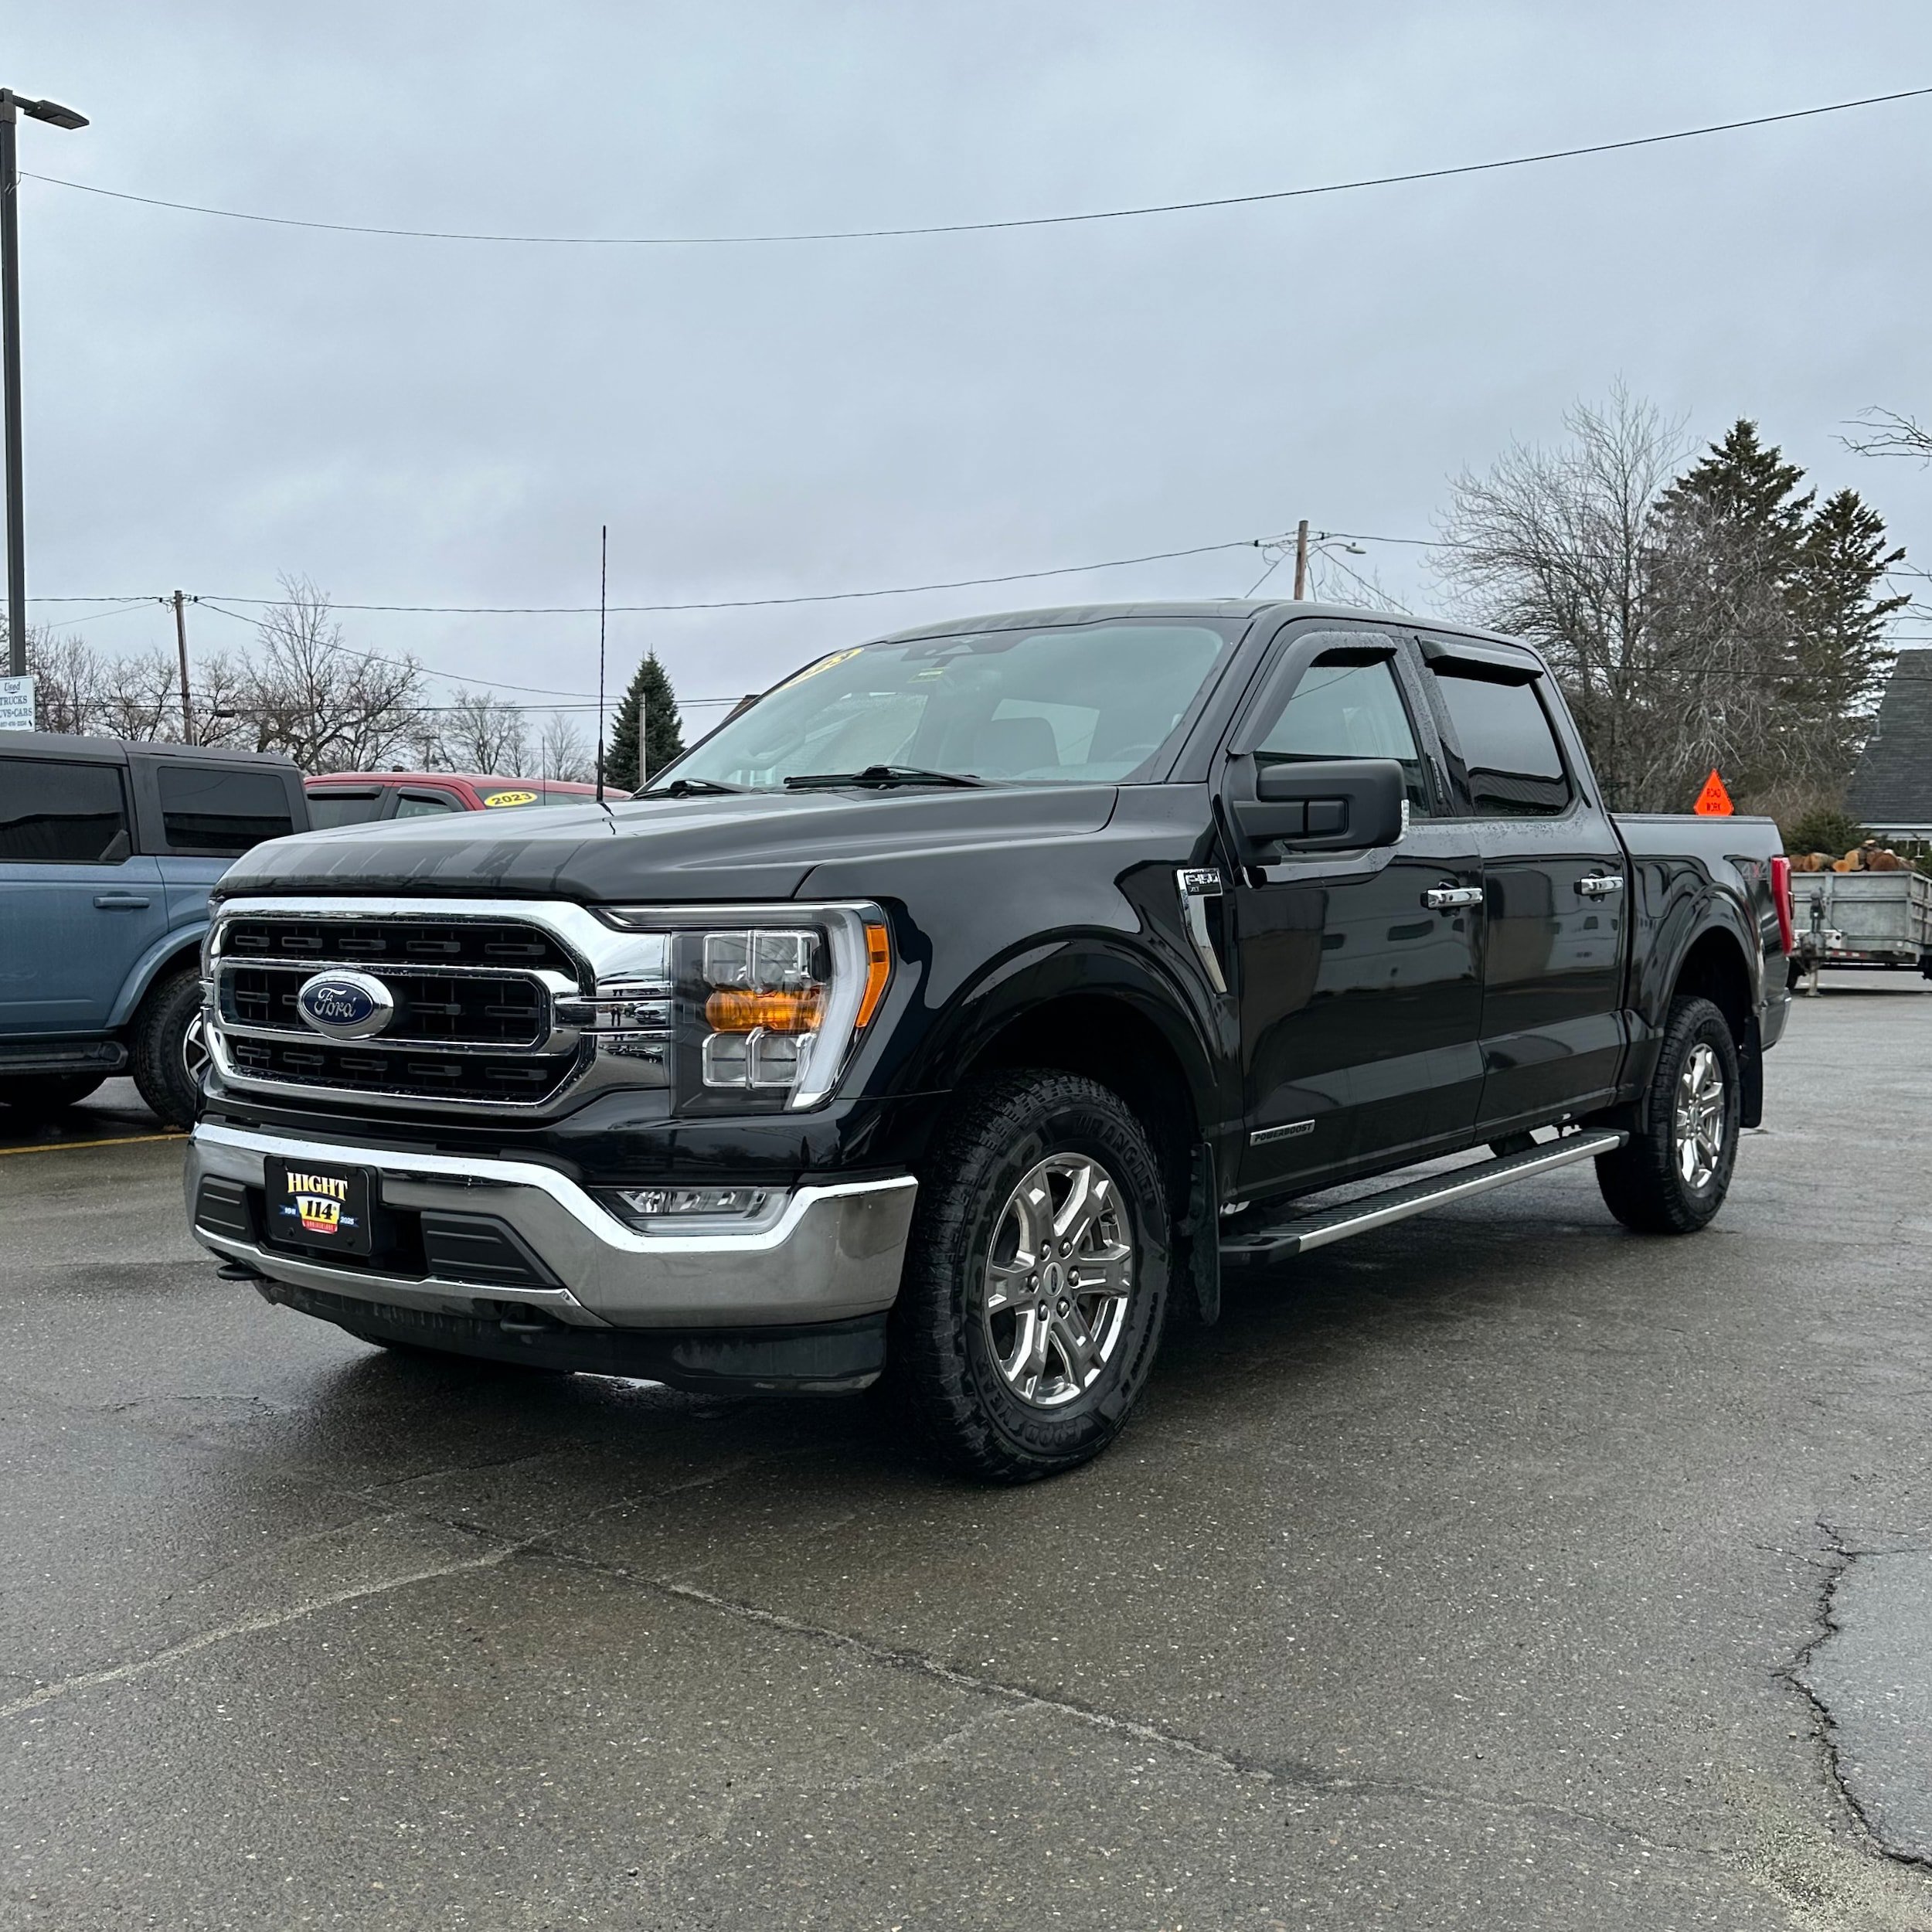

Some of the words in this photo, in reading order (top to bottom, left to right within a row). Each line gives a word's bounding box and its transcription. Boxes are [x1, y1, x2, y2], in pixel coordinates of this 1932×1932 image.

[4, 682, 21, 692] Used
[0, 696, 28, 706] TRUCKS
[491, 793, 532, 805] 2023
[314, 987, 358, 1018] Ford
[1253, 1123, 1312, 1142] POWERBOOST
[287, 1172, 349, 1202] HIGHT
[339, 1216, 355, 1226] 2025
